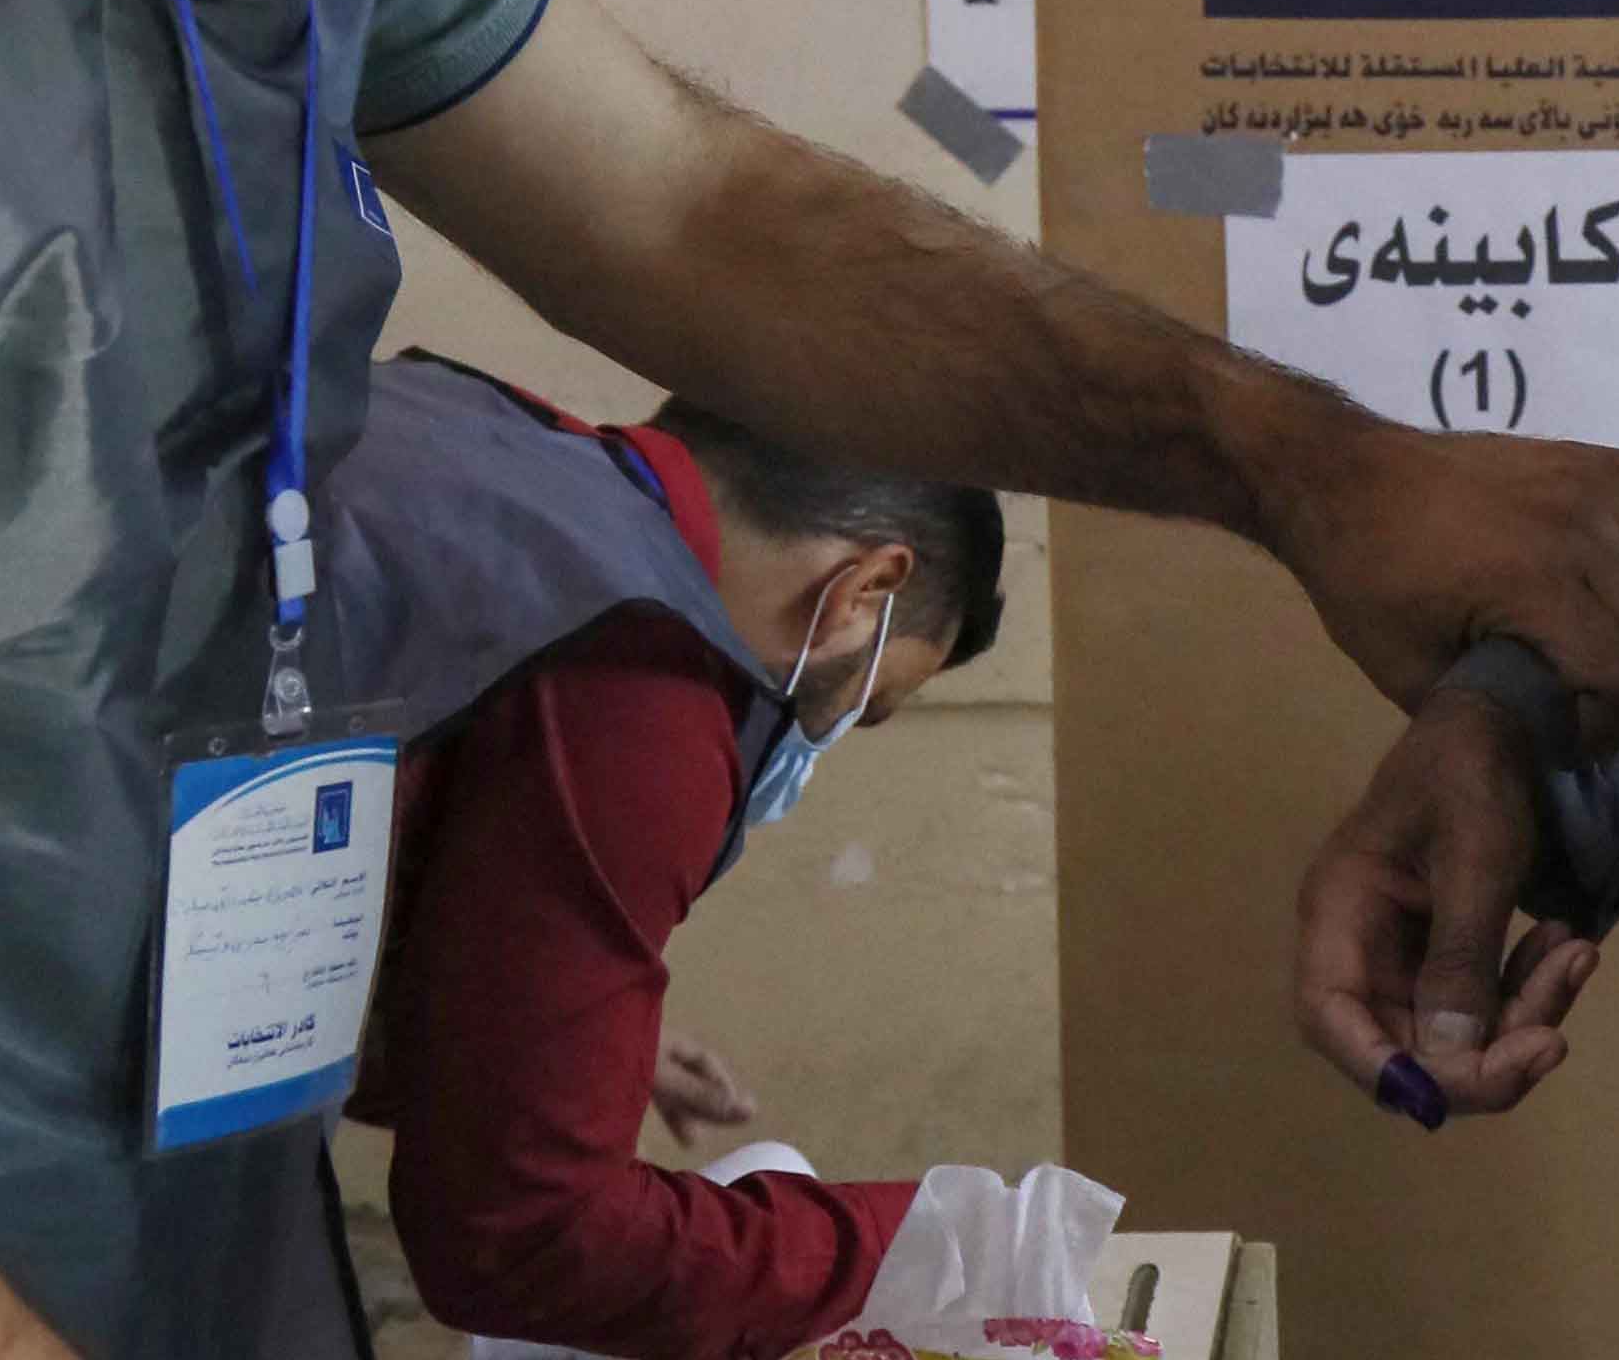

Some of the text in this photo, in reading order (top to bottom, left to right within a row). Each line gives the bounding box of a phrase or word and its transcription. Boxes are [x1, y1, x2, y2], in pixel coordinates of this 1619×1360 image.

[1200, 52, 1352, 85] للانتخابات
[1360, 52, 1479, 79] المستقلة
[1485, 55, 1566, 89] العليا
[1429, 347, 1528, 429] (1)
